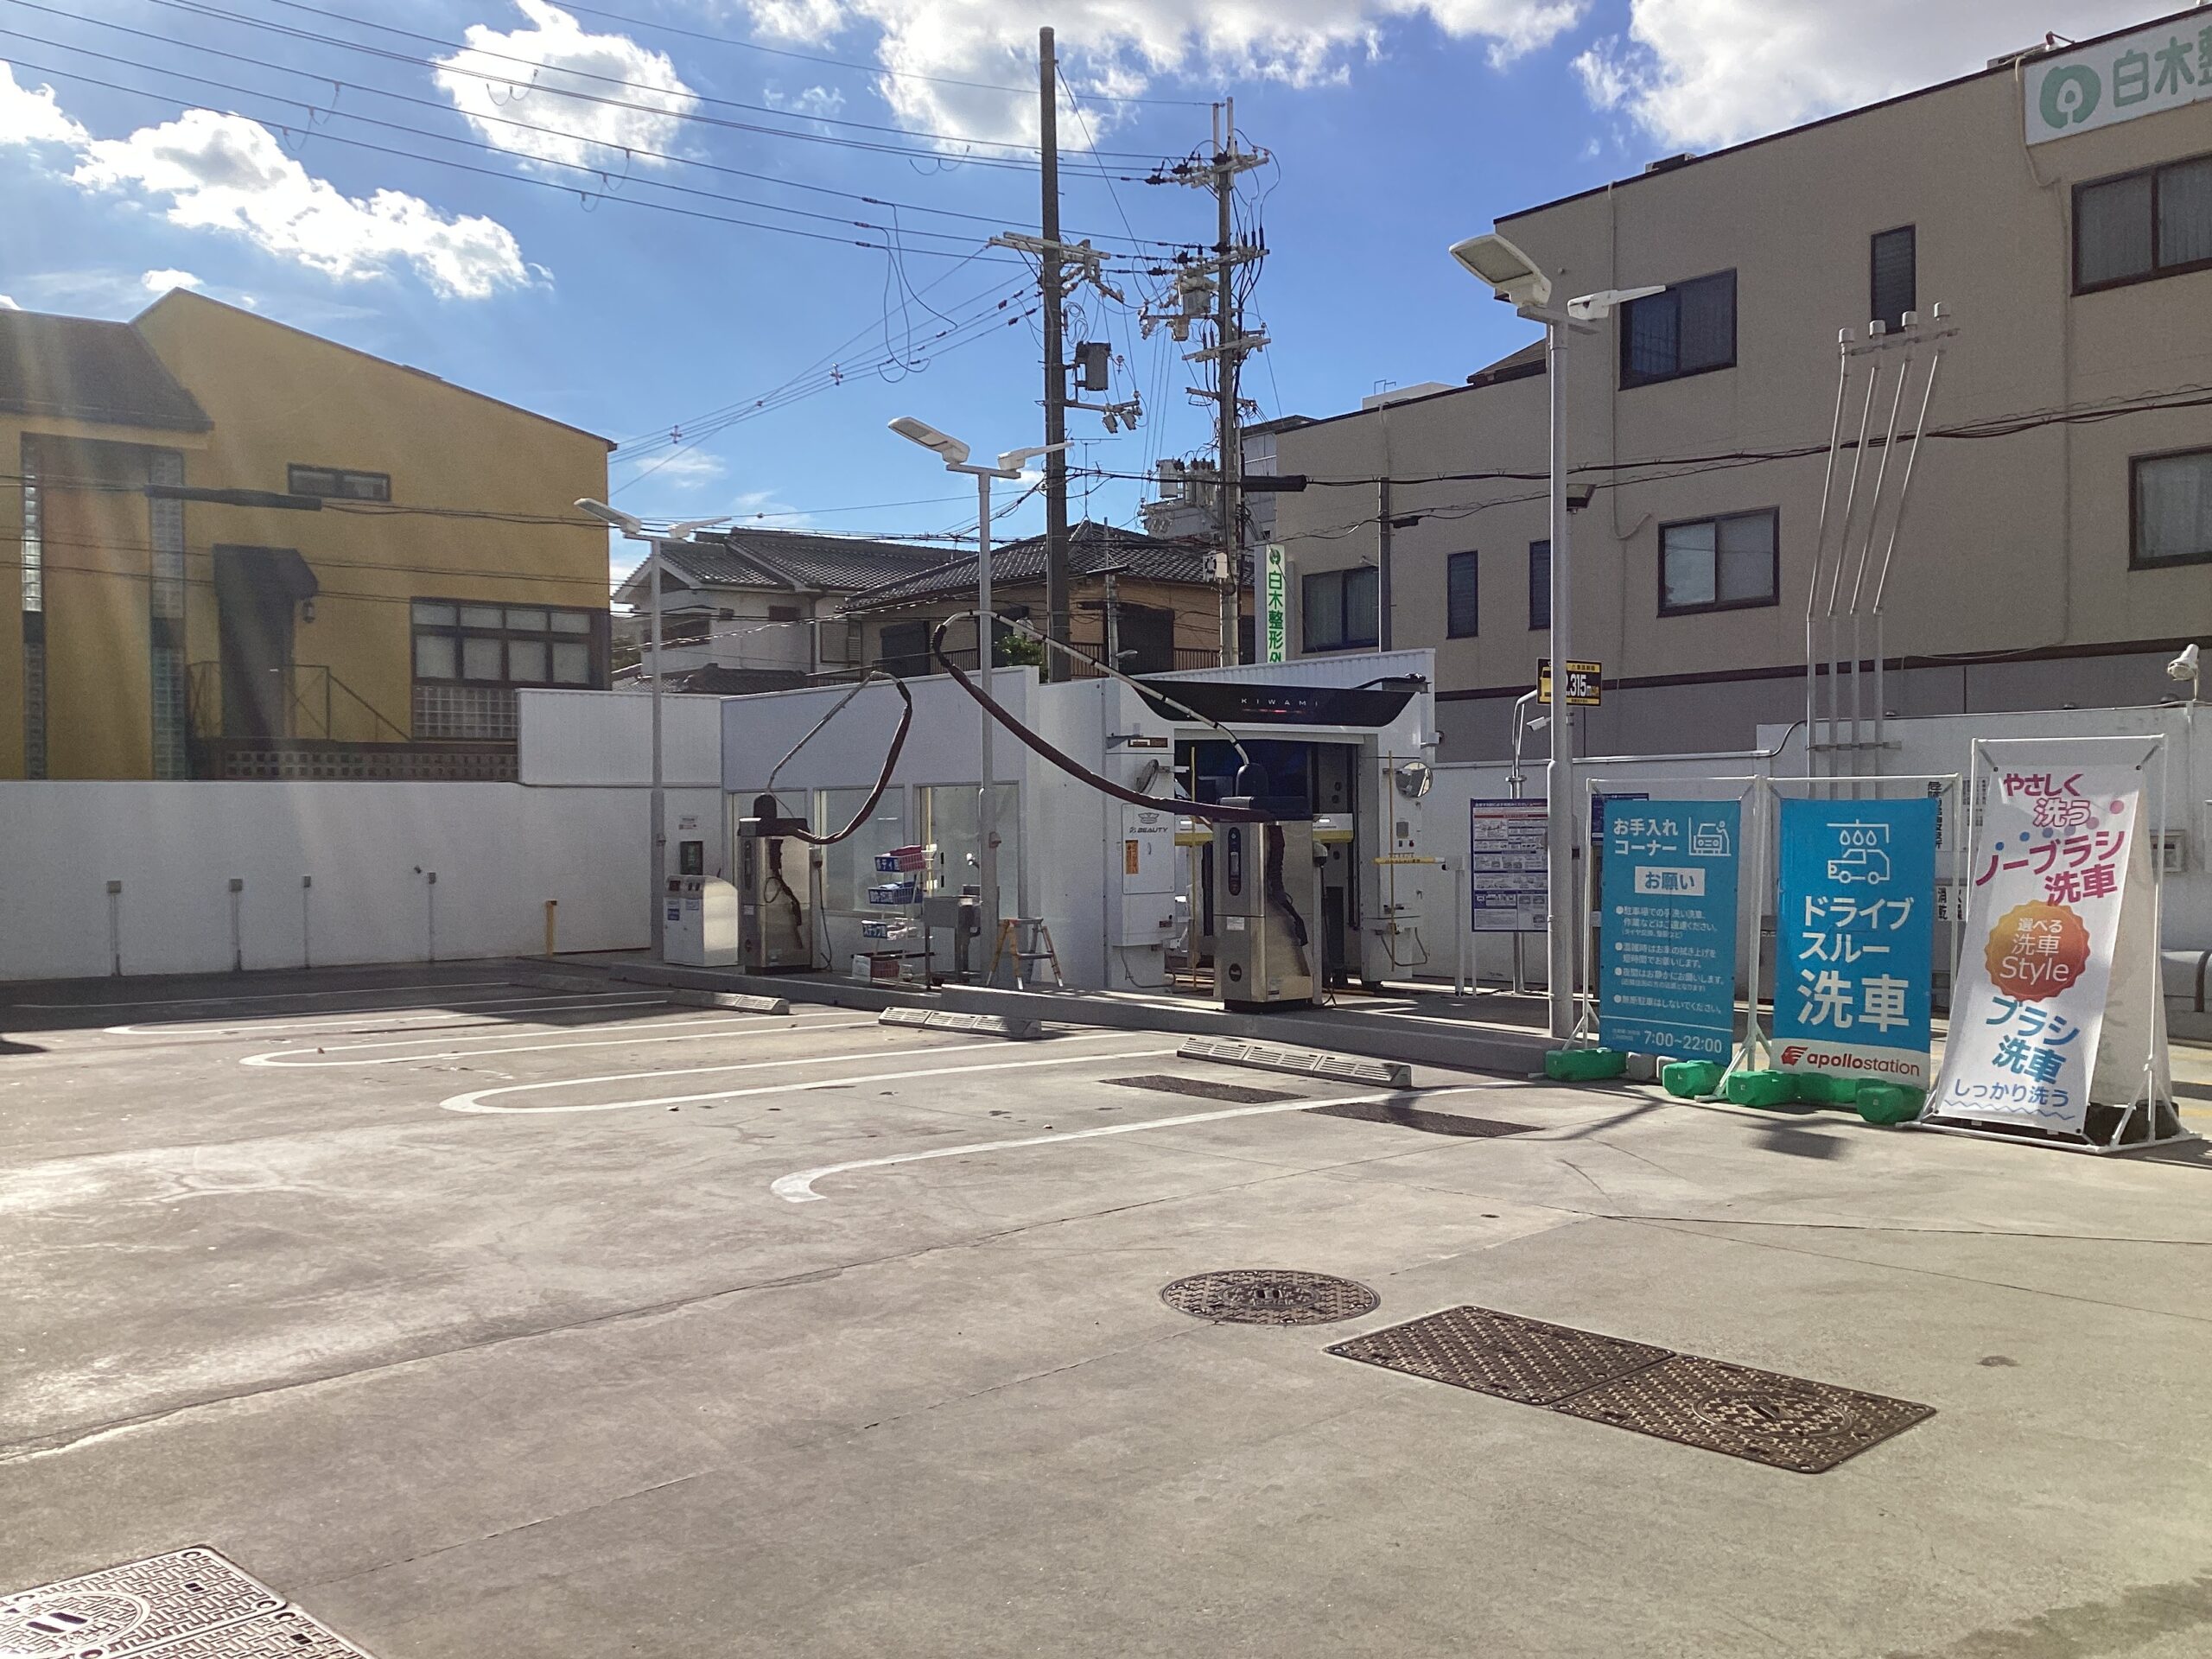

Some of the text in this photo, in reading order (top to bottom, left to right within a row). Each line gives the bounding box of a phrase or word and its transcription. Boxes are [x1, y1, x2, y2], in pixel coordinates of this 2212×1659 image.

[1241, 698, 1318, 707] KIWAMI
[2002, 772, 2084, 798] やさしく
[1613, 817, 1679, 836] お手入れ
[2032, 798, 2091, 829] 洗う
[1614, 839, 1677, 856] コーナー
[1974, 830, 2126, 887] ノーブラシ
[1644, 871, 1695, 891] お願い
[2043, 863, 2119, 907] 洗車
[1805, 895, 1915, 931] ドライブ
[2017, 917, 2063, 934] 選べる
[1798, 931, 1891, 963] スルー
[2011, 933, 2060, 957] 洗車
[1999, 956, 2069, 984] Style
[1797, 969, 1910, 1033] 洗車
[1986, 995, 2082, 1047] ブラシ
[1807, 1049, 1920, 1077] apollostation
[1992, 1035, 2067, 1084] 洗車
[1954, 1077, 2069, 1108] しっかり洗う
